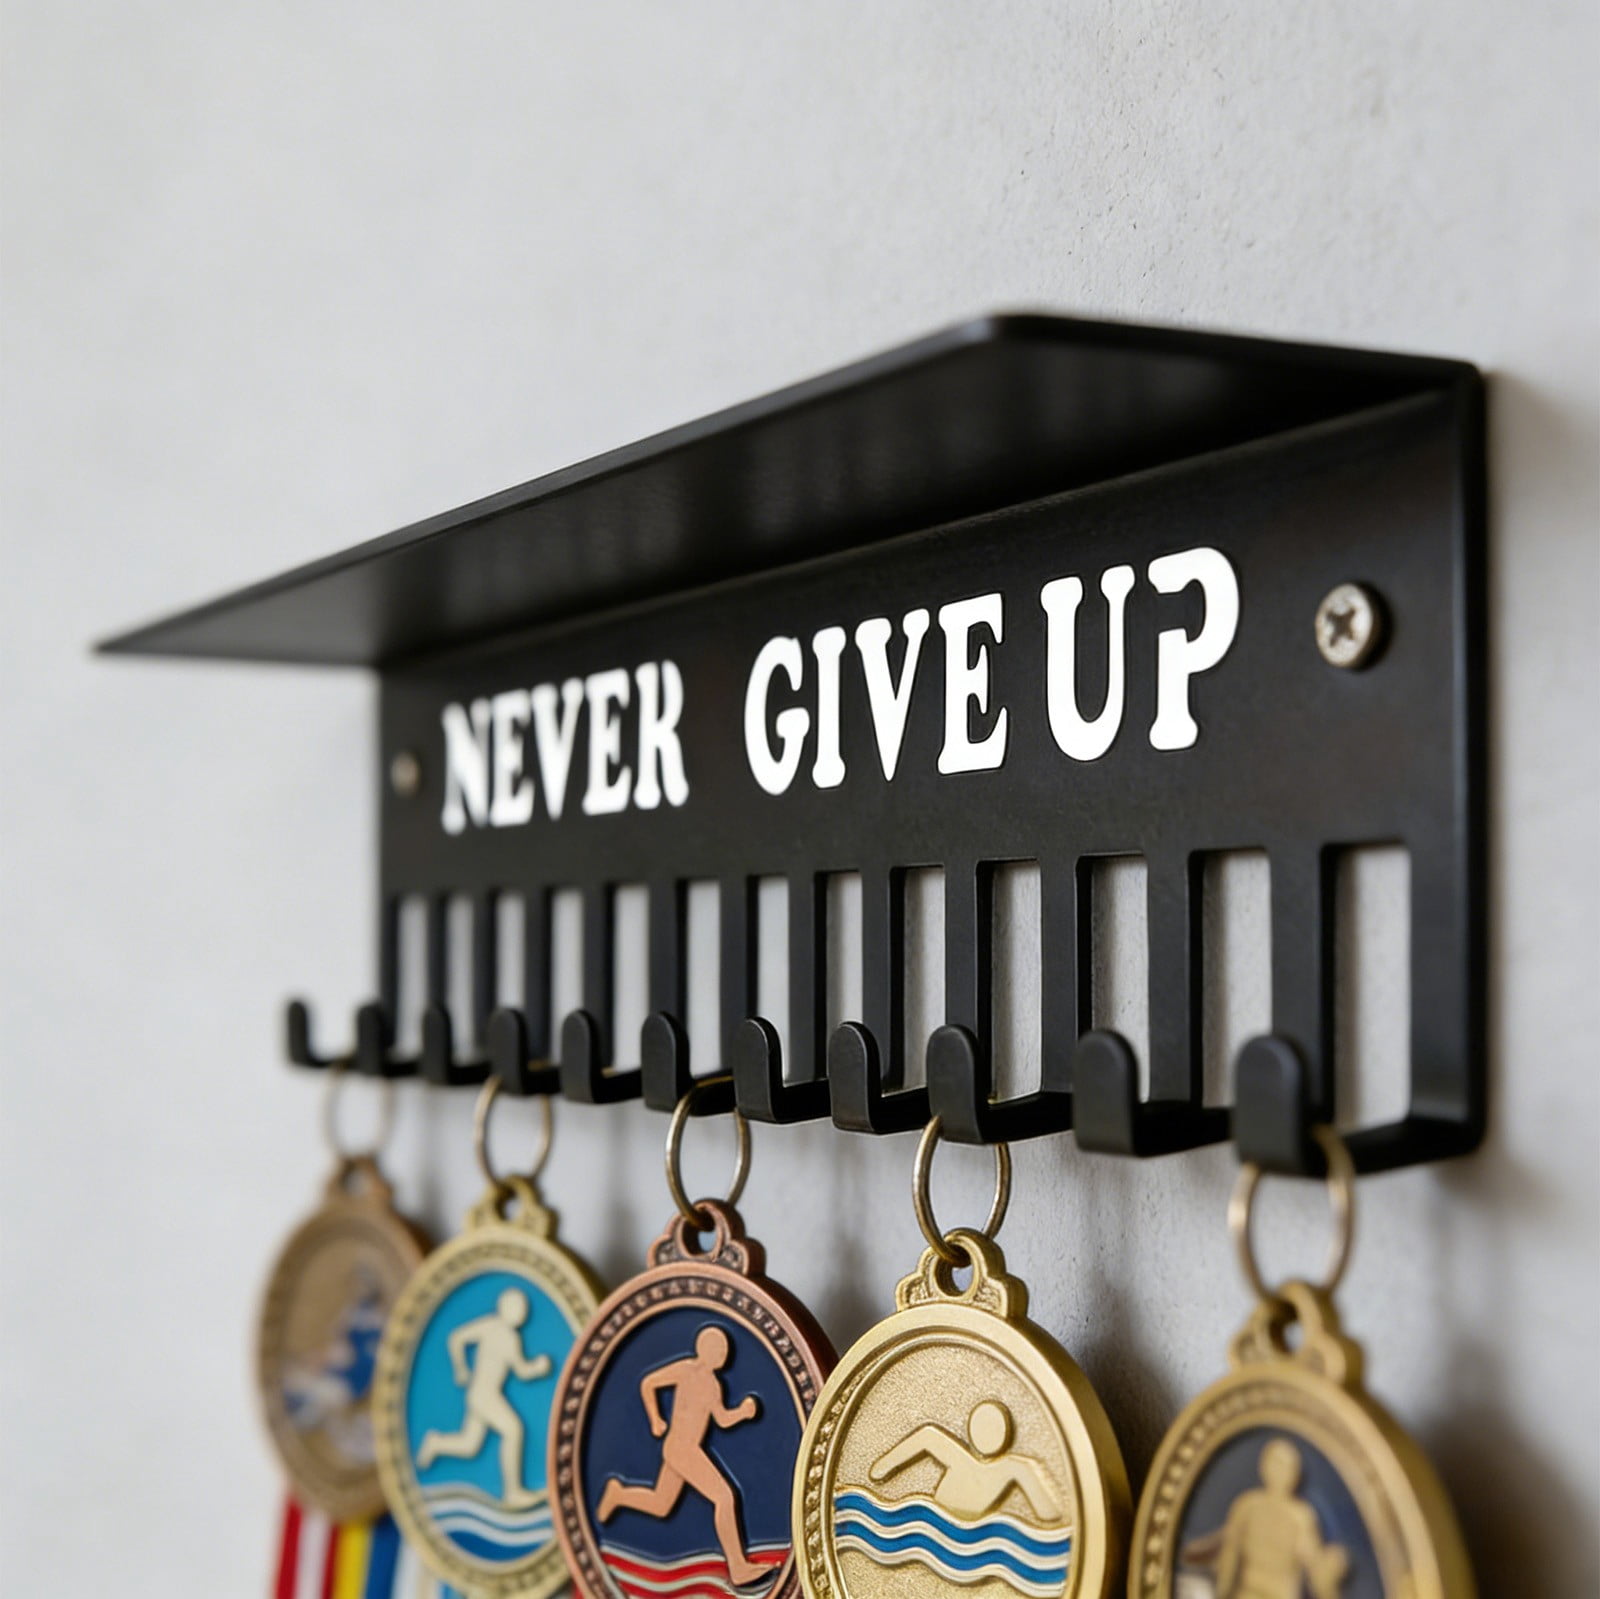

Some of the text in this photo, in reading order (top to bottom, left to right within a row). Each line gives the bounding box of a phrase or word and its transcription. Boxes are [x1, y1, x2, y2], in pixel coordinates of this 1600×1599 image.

[441, 546, 1240, 836] NEVER GIVE UP
